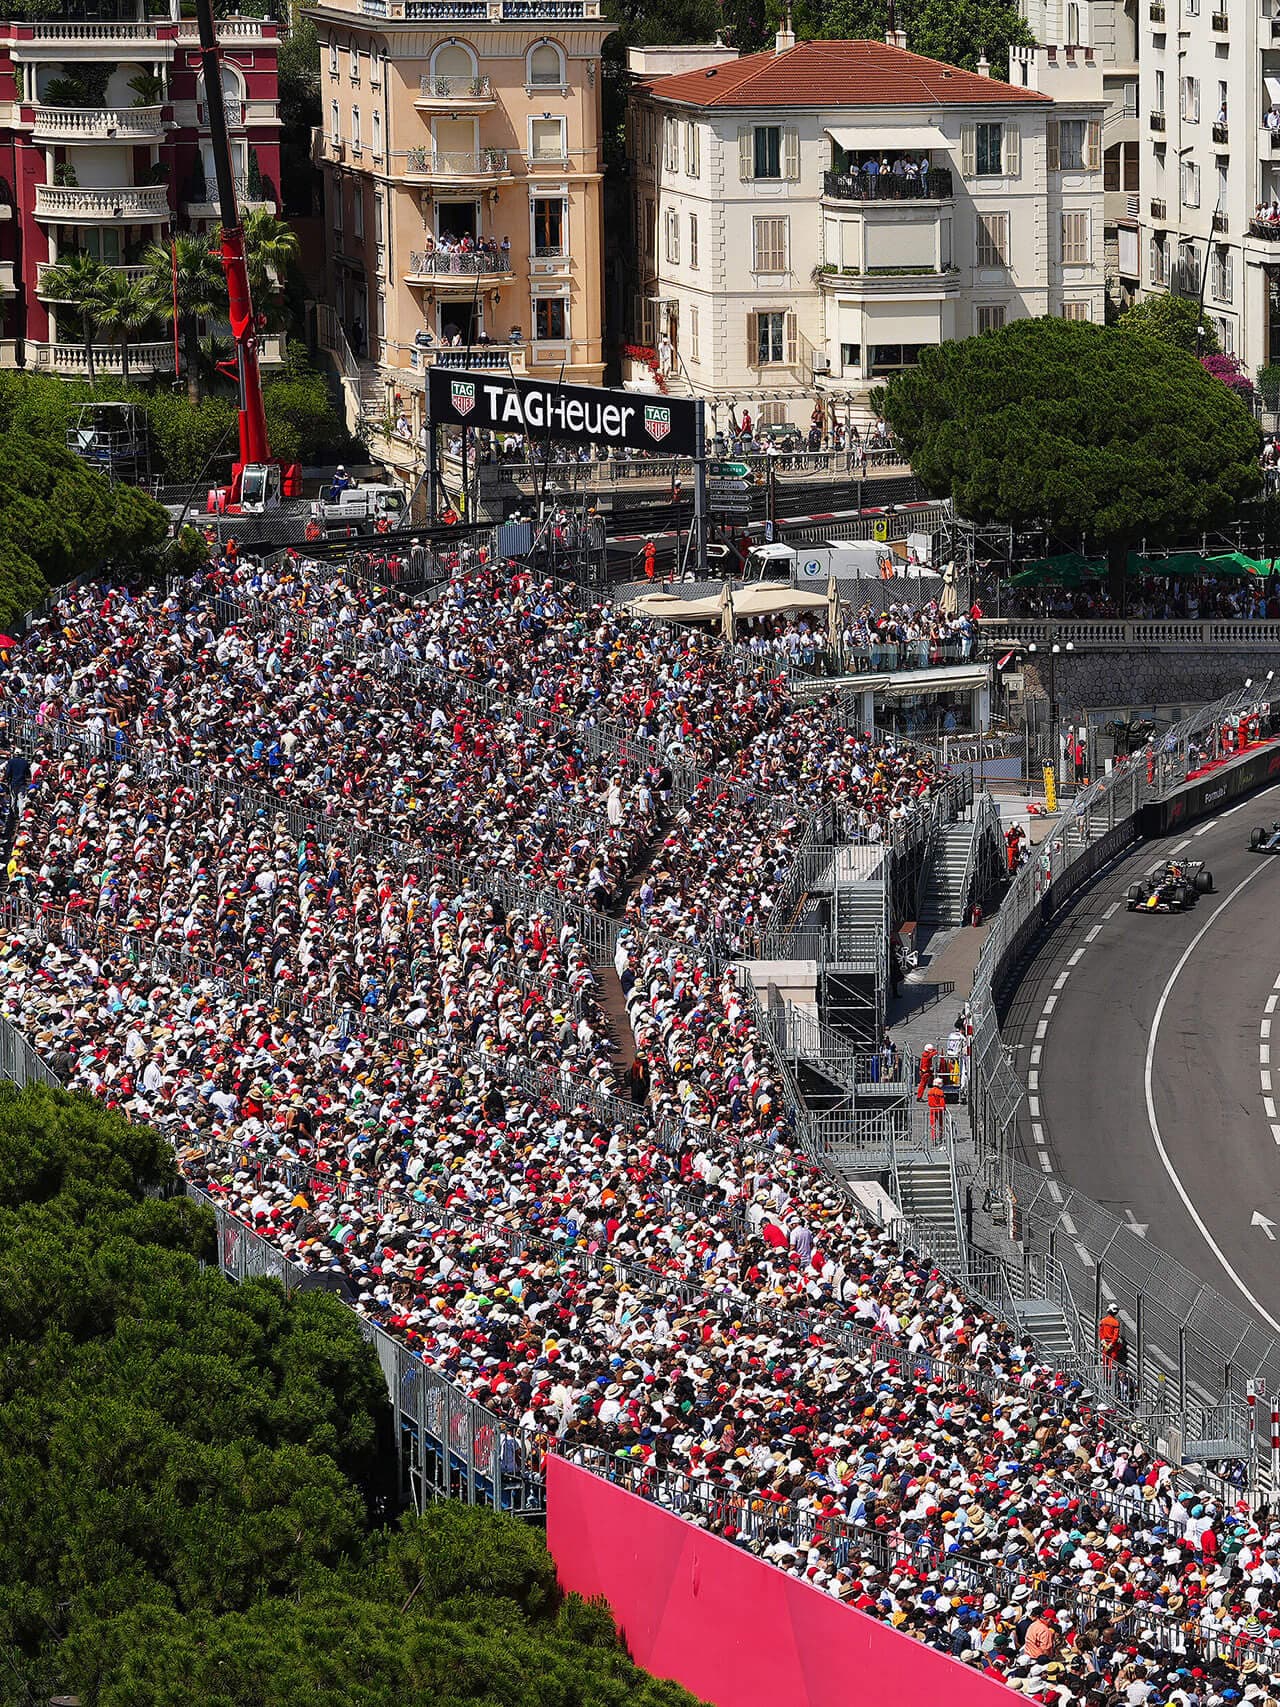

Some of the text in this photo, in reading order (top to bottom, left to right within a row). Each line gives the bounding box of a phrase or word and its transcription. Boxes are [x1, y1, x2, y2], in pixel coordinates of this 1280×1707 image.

[453, 383, 474, 396] TAG
[452, 397, 475, 412] HEUER
[648, 408, 668, 421] TAG
[646, 420, 670, 437] HEUER
